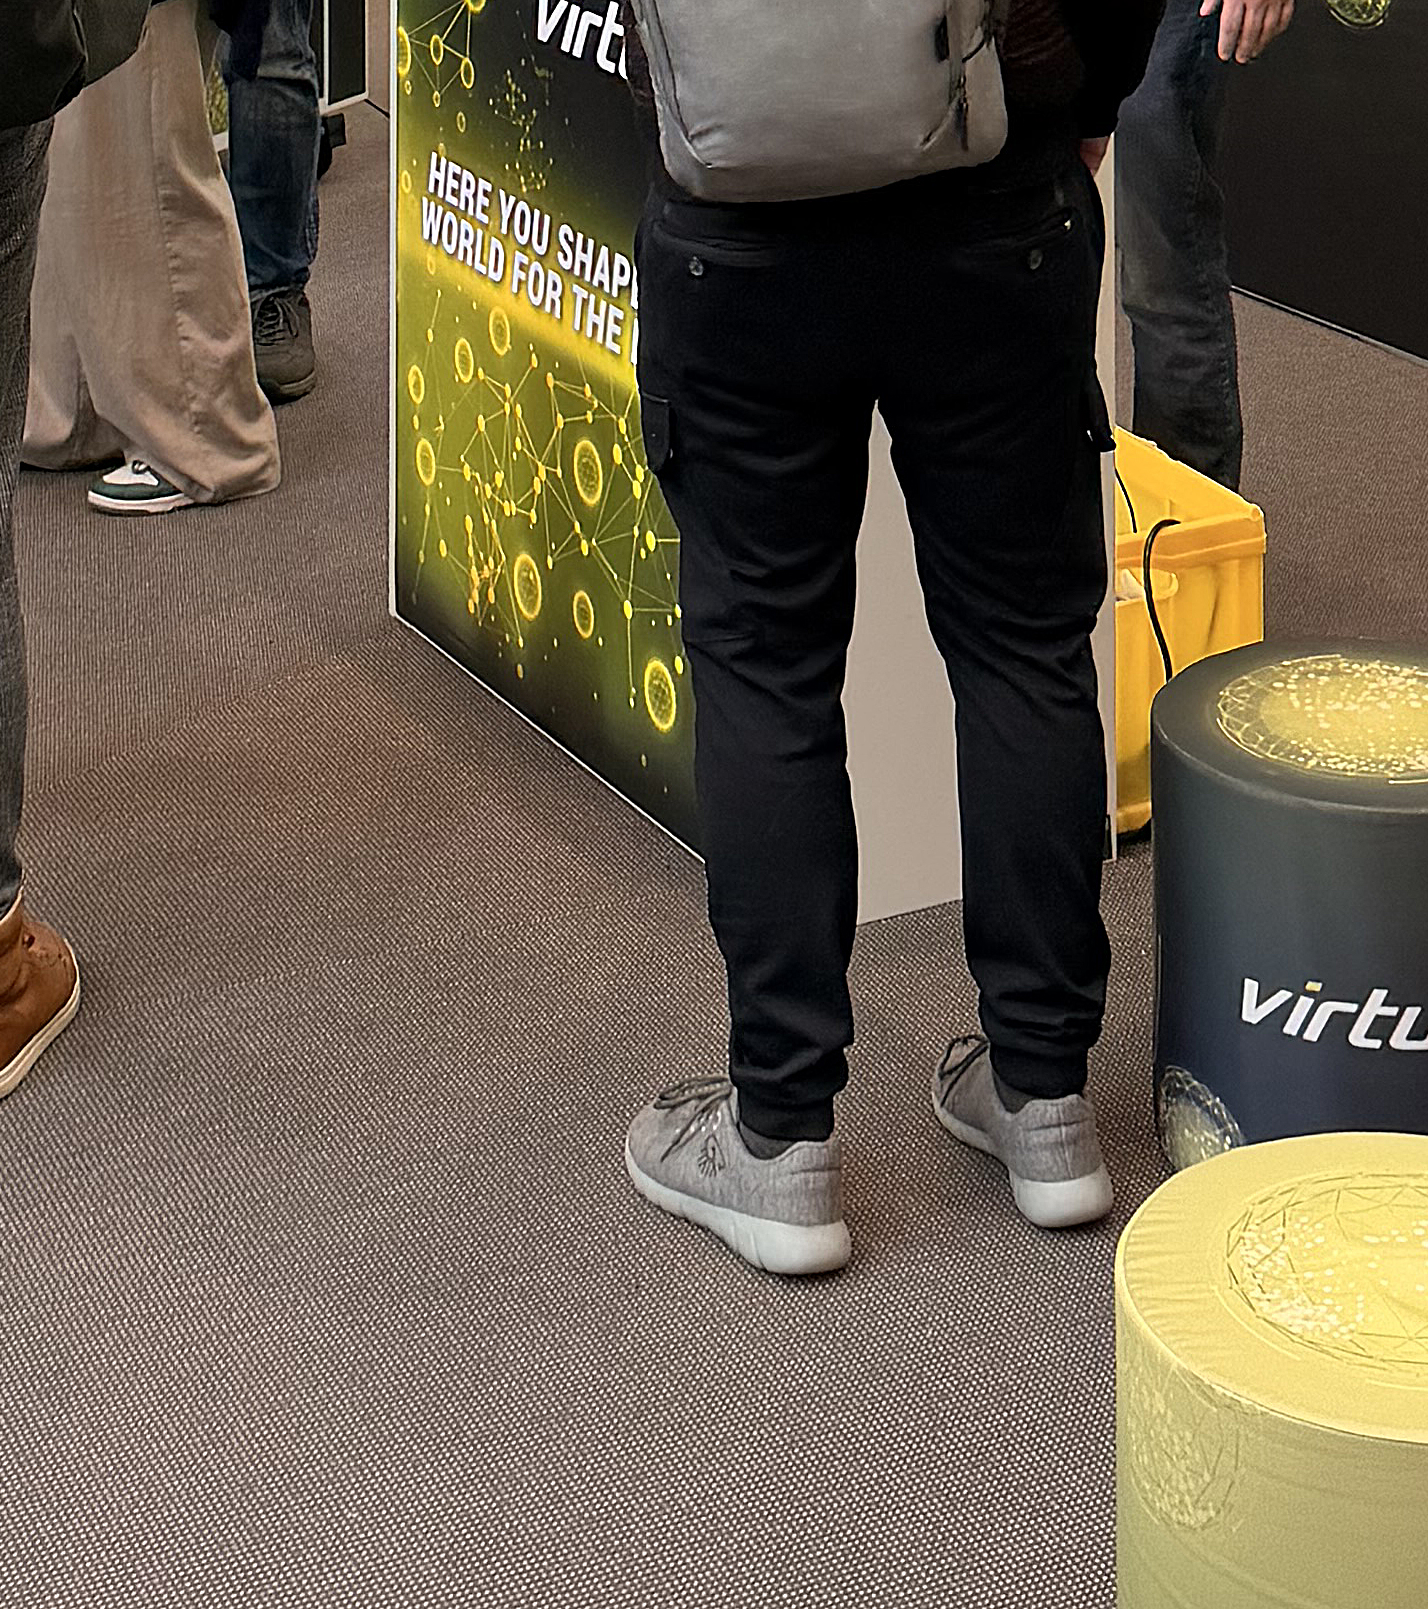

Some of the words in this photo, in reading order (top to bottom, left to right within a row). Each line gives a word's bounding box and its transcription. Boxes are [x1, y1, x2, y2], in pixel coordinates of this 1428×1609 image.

[428, 151, 492, 224] HERE
[499, 188, 551, 257] YOU
[421, 196, 505, 283] WORLD
[511, 248, 563, 320] FOR
[572, 282, 625, 356] THE
